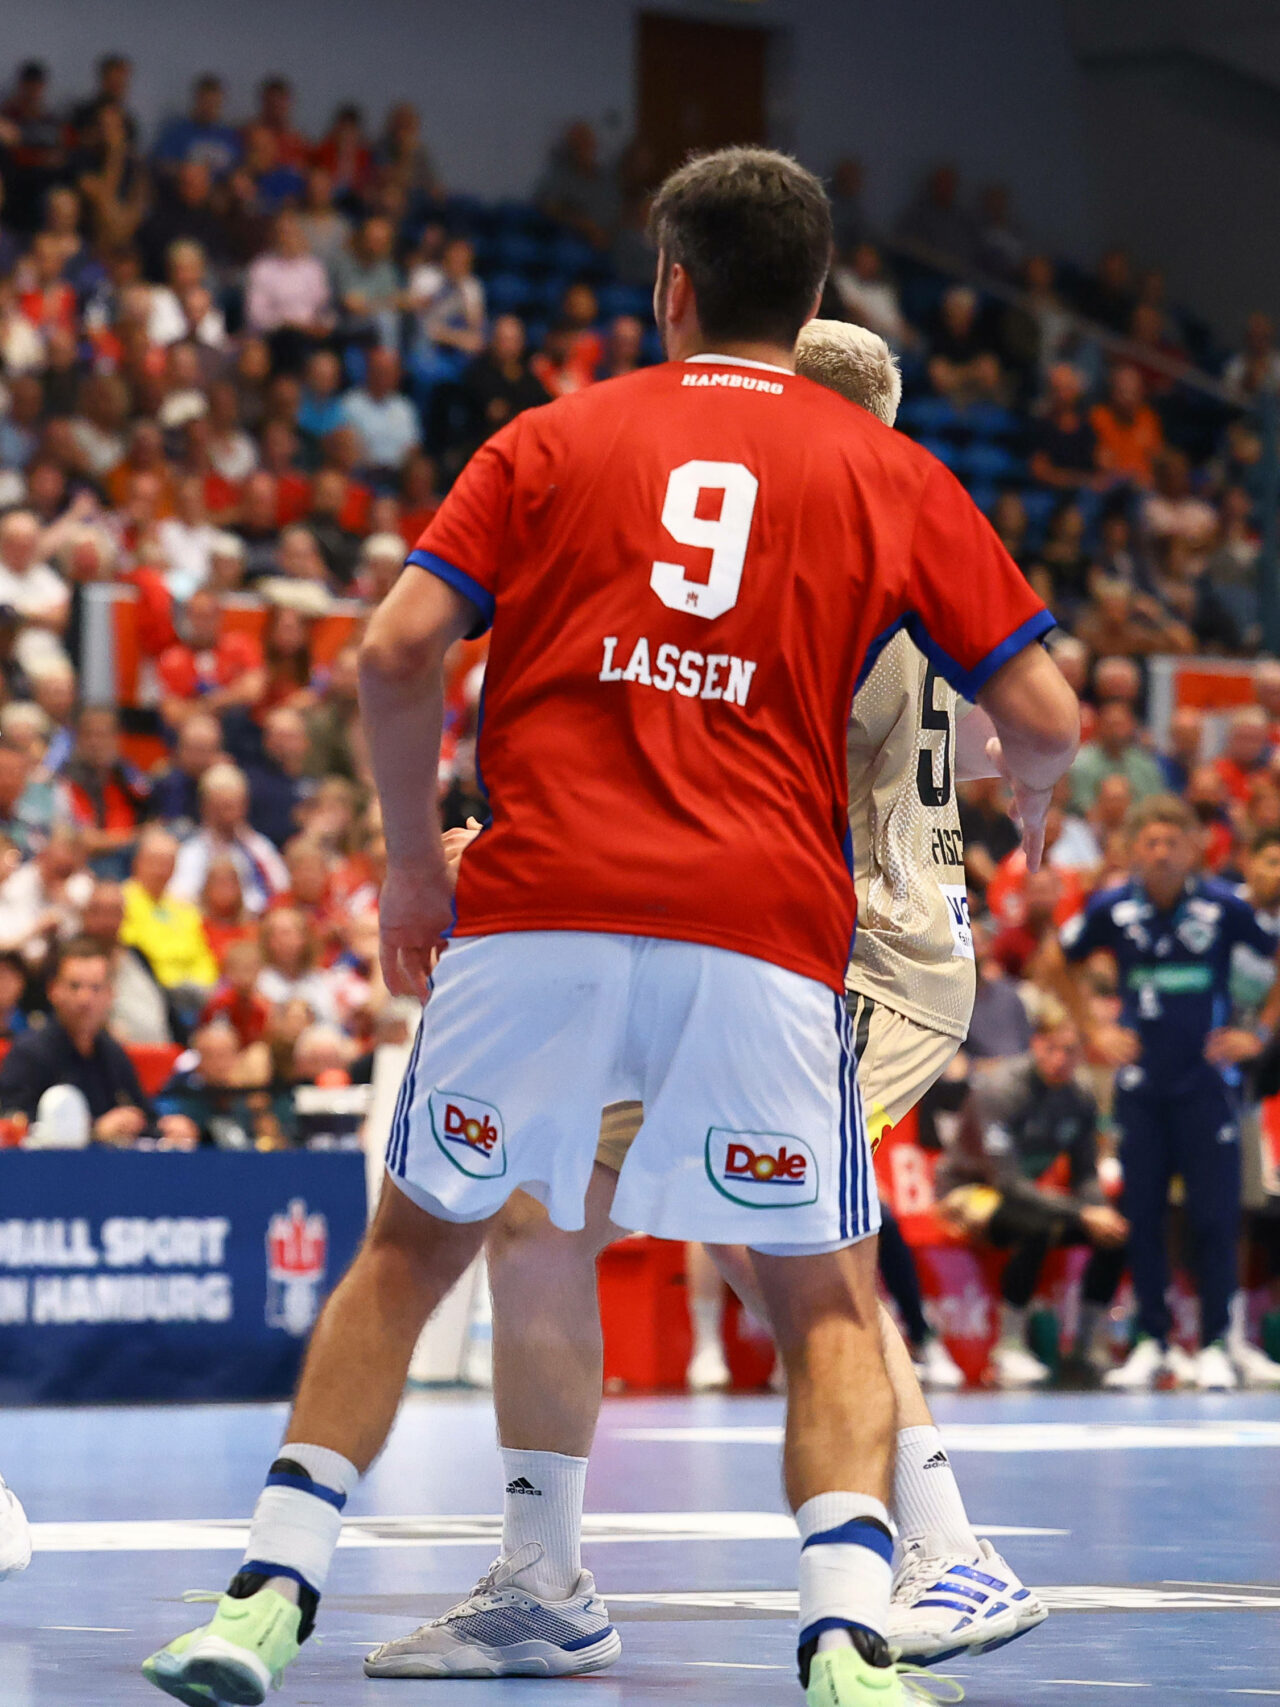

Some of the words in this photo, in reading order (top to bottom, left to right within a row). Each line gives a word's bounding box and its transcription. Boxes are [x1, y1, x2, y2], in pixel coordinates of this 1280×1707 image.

[681, 373, 784, 395] HAMBURG
[650, 459, 759, 620] 9
[599, 636, 757, 707] LASSEN
[445, 1103, 498, 1150] Dole
[725, 1143, 807, 1182] Dole
[101, 1215, 231, 1268] SPORT
[32, 1273, 233, 1325] HAMBURG
